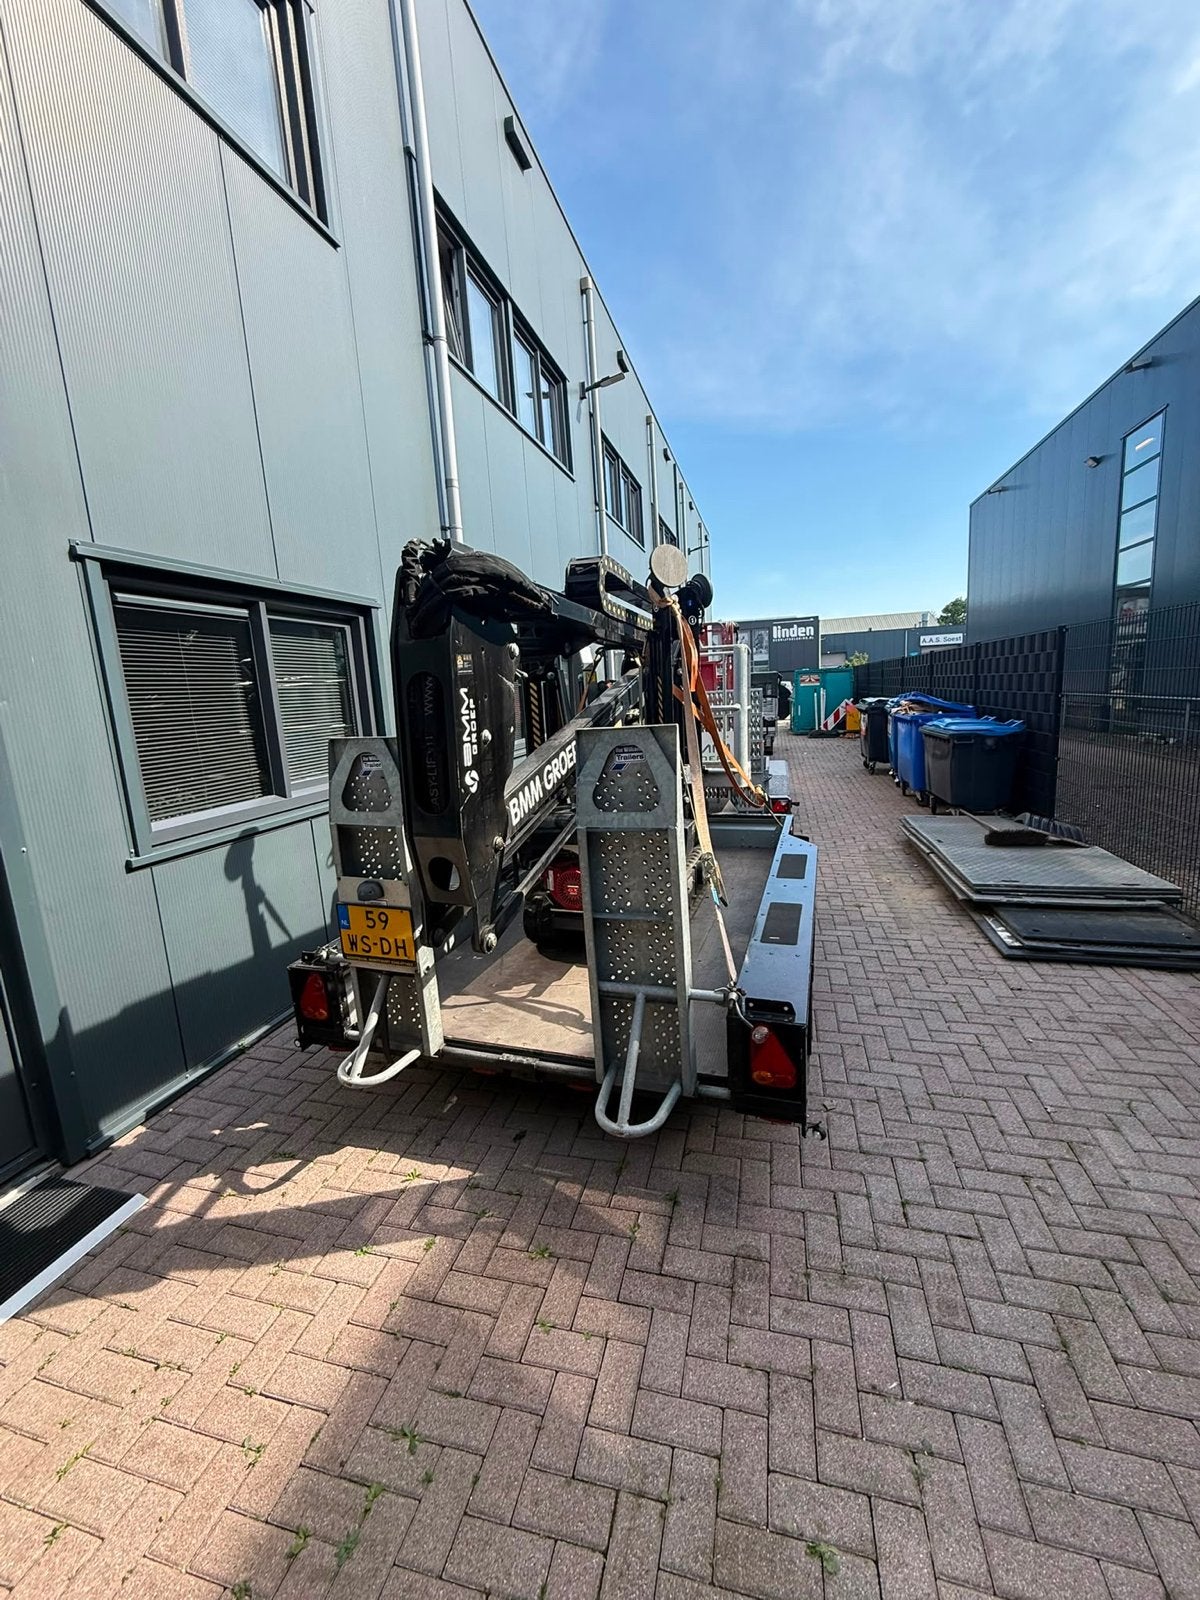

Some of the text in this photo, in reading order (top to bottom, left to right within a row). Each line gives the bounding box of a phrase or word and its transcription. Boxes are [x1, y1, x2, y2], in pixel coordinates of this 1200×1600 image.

[772, 624, 815, 639] linden
[921, 635, 962, 644] A.A.S. Soest
[459, 687, 473, 767] BMM
[508, 778, 544, 827] BMM
[364, 910, 390, 931] 59
[346, 933, 409, 959] WS-DH
